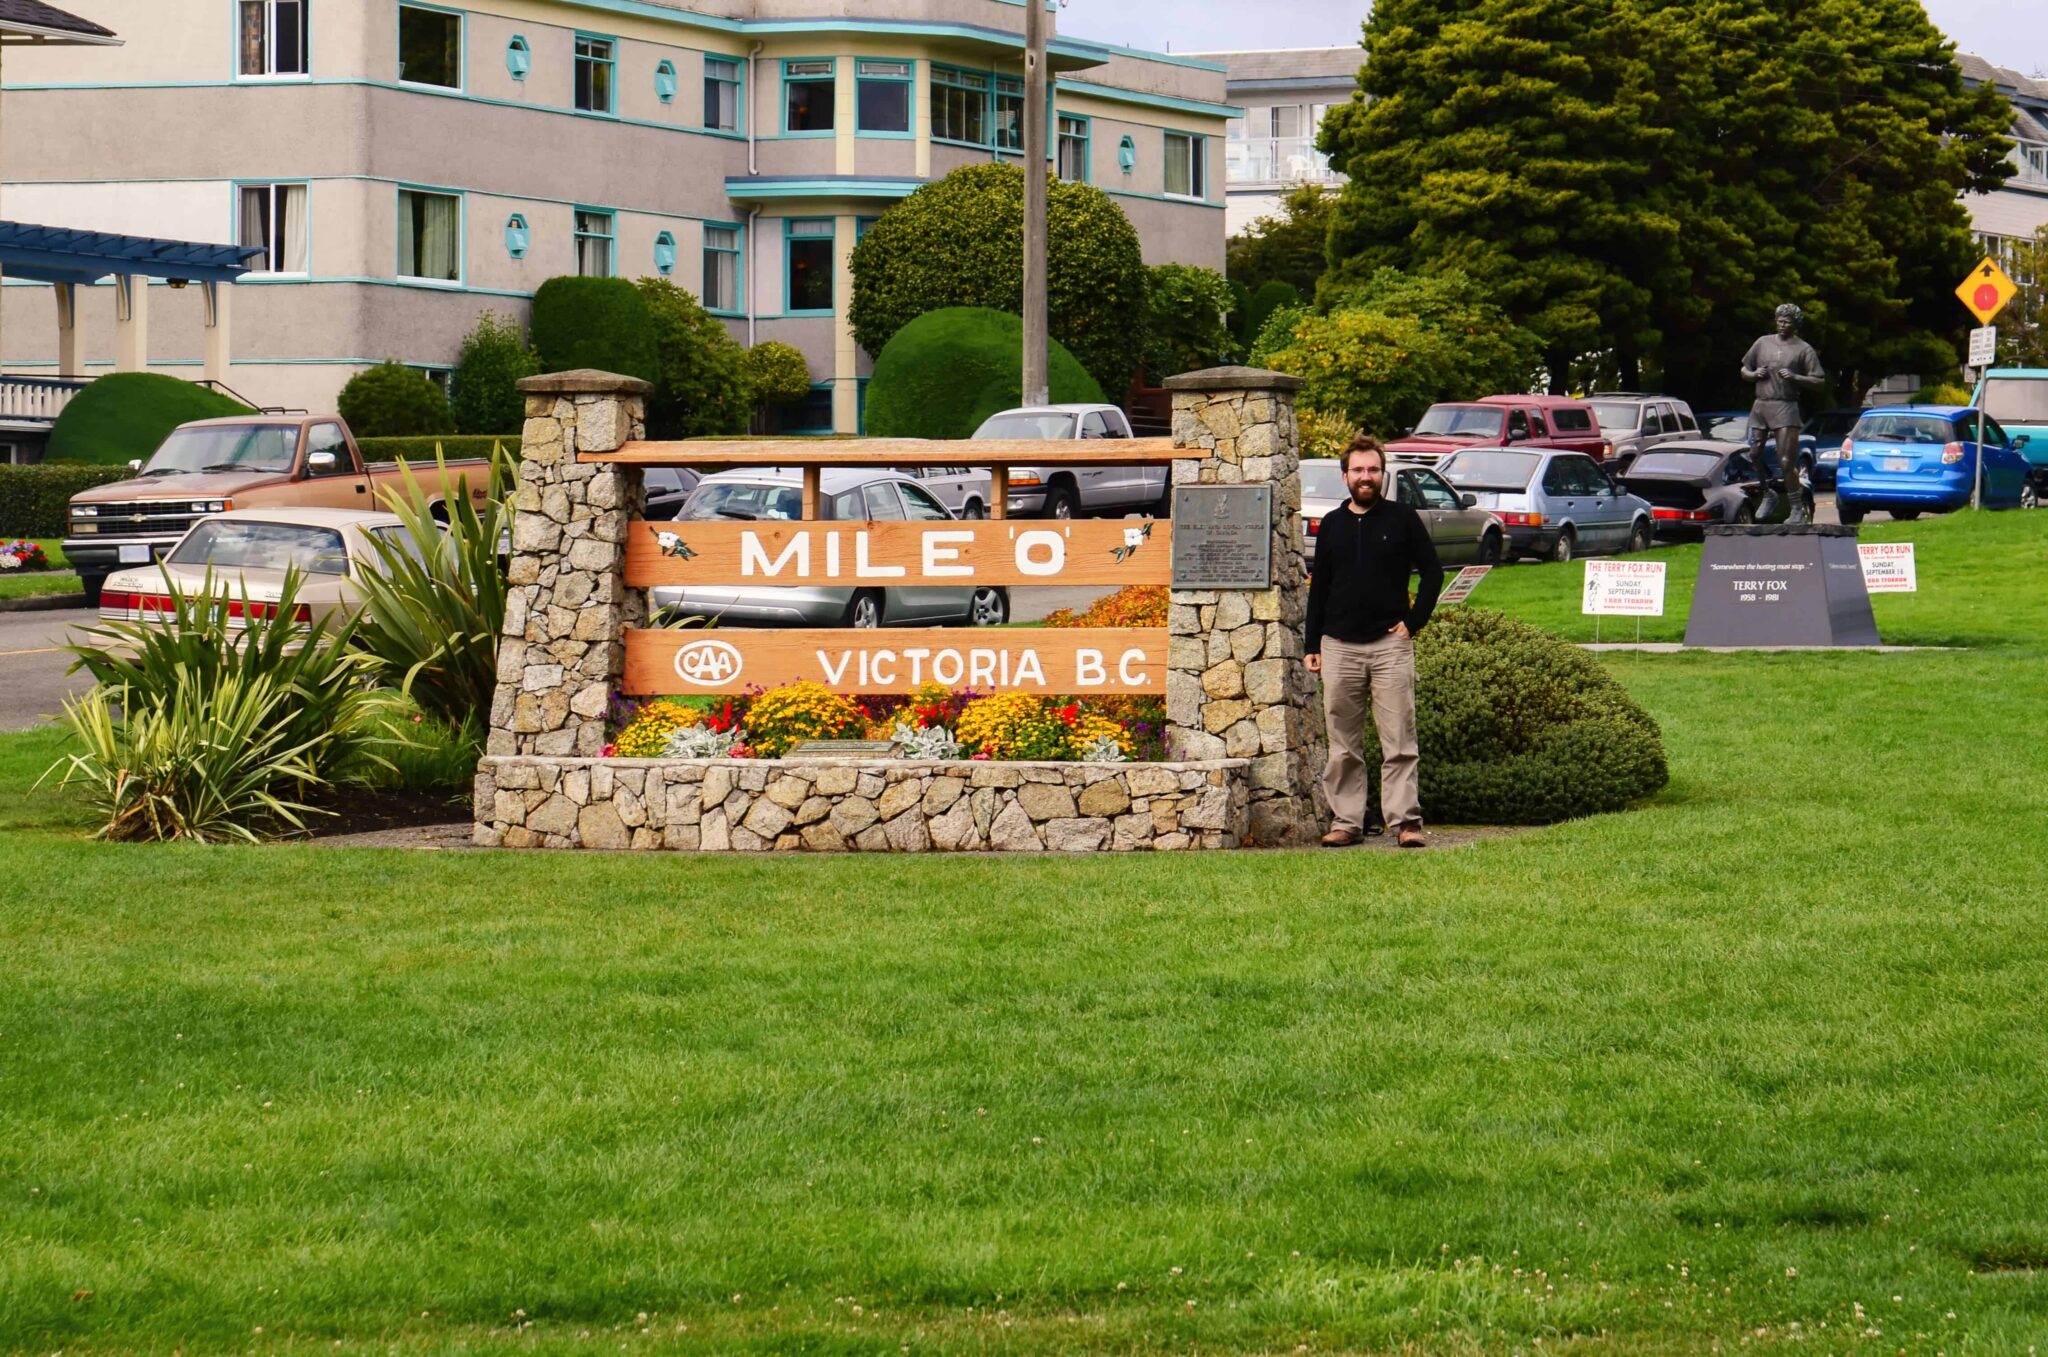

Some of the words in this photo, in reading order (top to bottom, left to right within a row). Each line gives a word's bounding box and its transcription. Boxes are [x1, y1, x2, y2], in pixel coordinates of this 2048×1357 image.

[741, 530, 975, 578] MILE
[1859, 545, 1878, 555] TERRY
[1881, 545, 1894, 554] FOX
[1896, 545, 1911, 554] RUN
[1588, 562, 1602, 572] THE
[1604, 562, 1626, 572] TERRY
[1628, 563, 1643, 573] FOX
[1646, 563, 1662, 573] RUN
[1733, 580, 1765, 590] TERRY
[1766, 580, 1788, 590] FOX
[682, 646, 733, 680] CAA
[816, 648, 1046, 686] VICTORIA
[1076, 648, 1151, 686] B.C.
